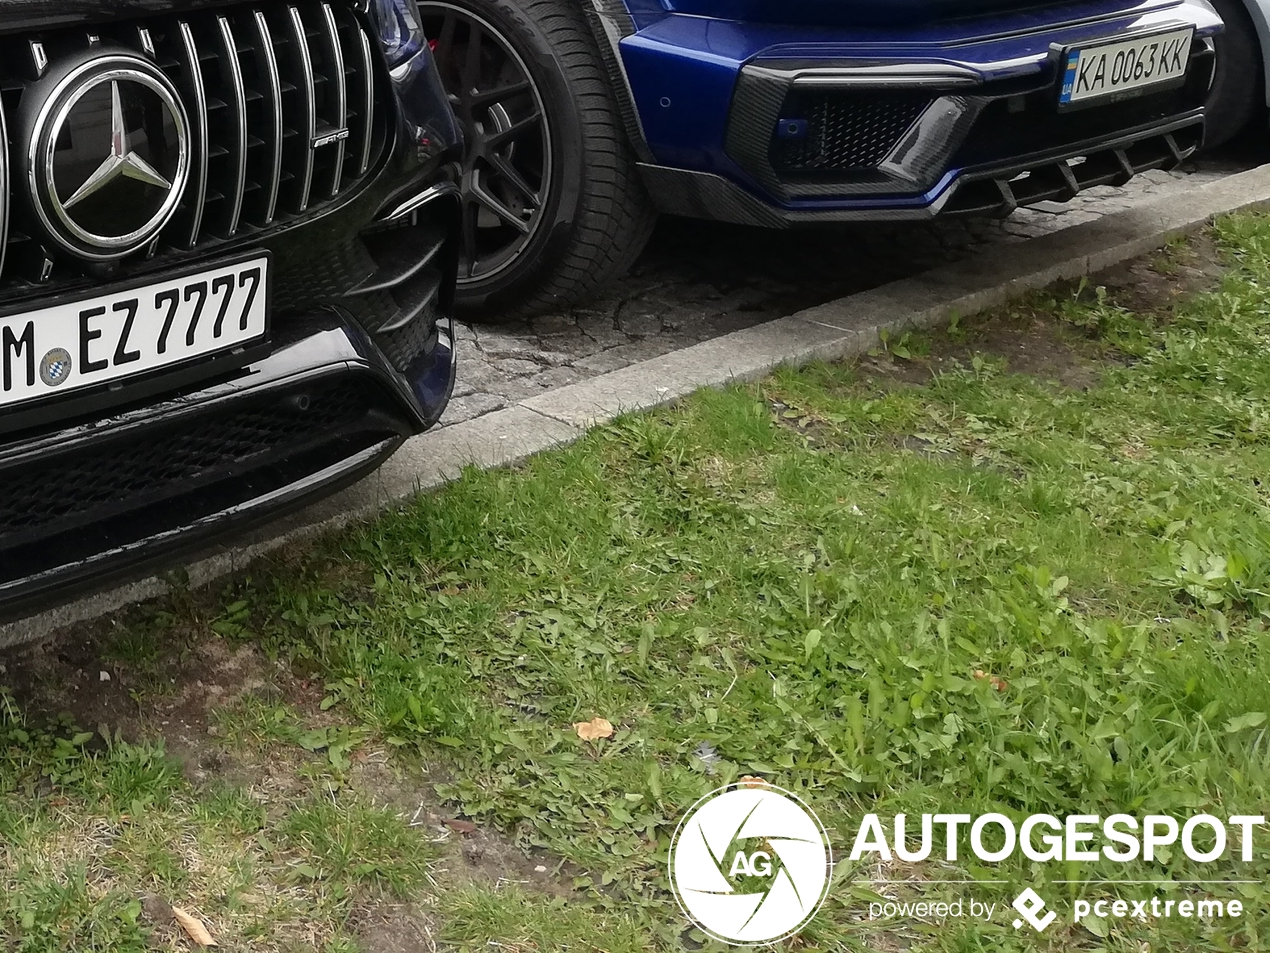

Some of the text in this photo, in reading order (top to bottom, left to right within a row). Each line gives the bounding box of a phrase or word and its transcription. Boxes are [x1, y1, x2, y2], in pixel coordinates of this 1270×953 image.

[1062, 84, 1072, 96] UA
[1076, 36, 1188, 93] KA 0063 KK
[79, 298, 141, 374] EZ
[155, 268, 261, 354] 7777
